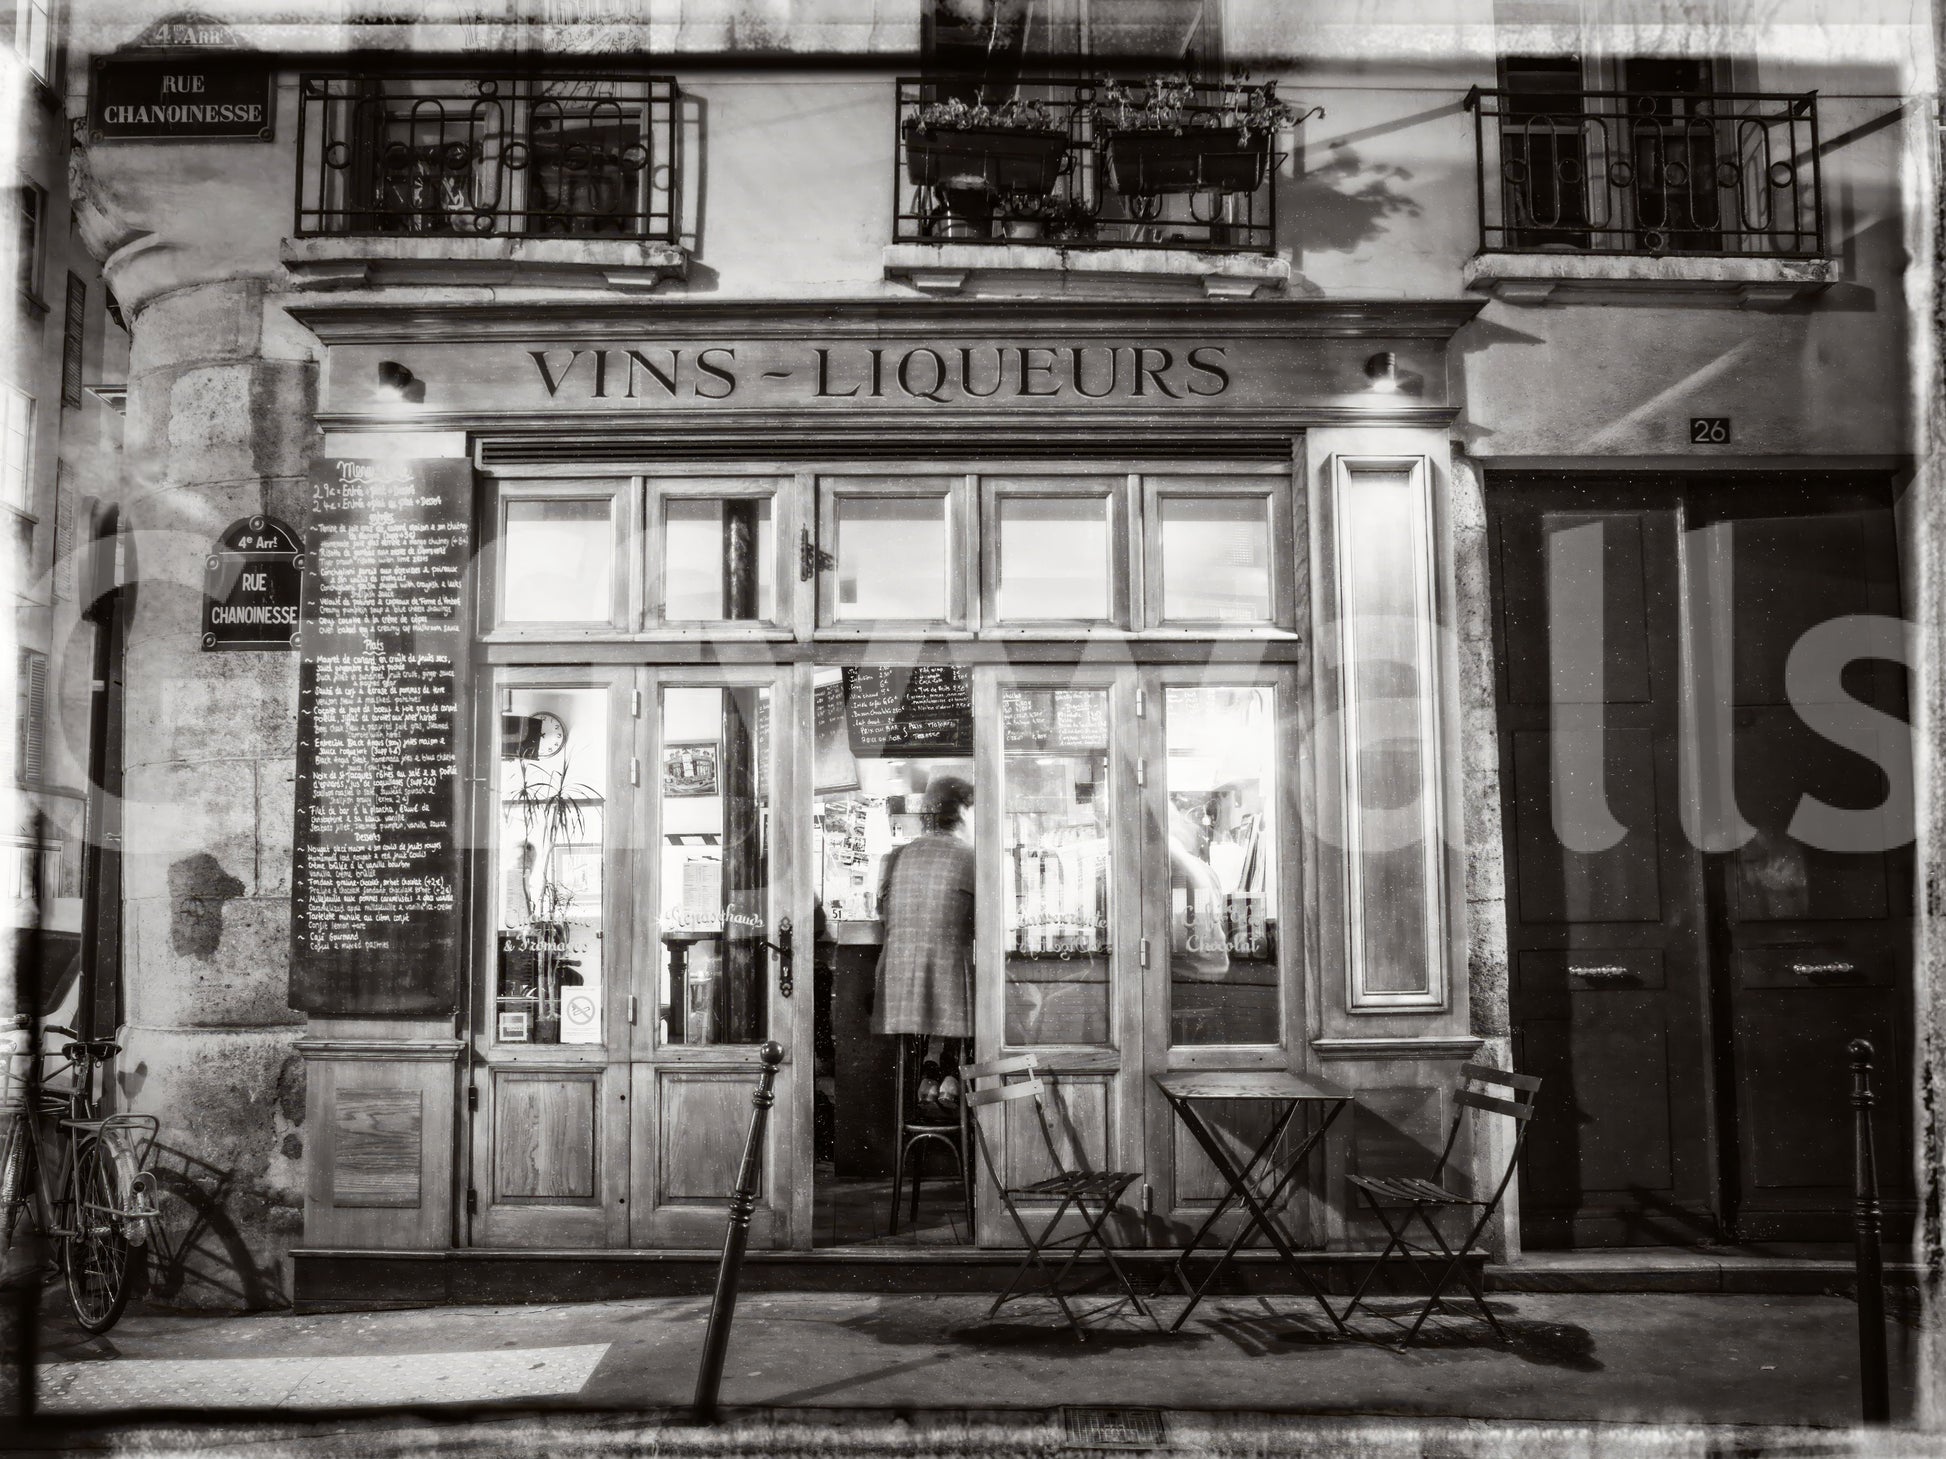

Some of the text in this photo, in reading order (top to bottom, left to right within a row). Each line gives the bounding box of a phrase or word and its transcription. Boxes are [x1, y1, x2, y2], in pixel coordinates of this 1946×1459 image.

[163, 76, 205, 93] RUE
[104, 105, 261, 123] CHANOINESSE
[527, 348, 736, 398] VINS
[812, 347, 1229, 401] LIQUEURS
[1694, 420, 1726, 442] 26
[242, 574, 266, 591] RUE
[212, 607, 297, 624] CHANOINESSE
[363, 639, 384, 651] Plats
